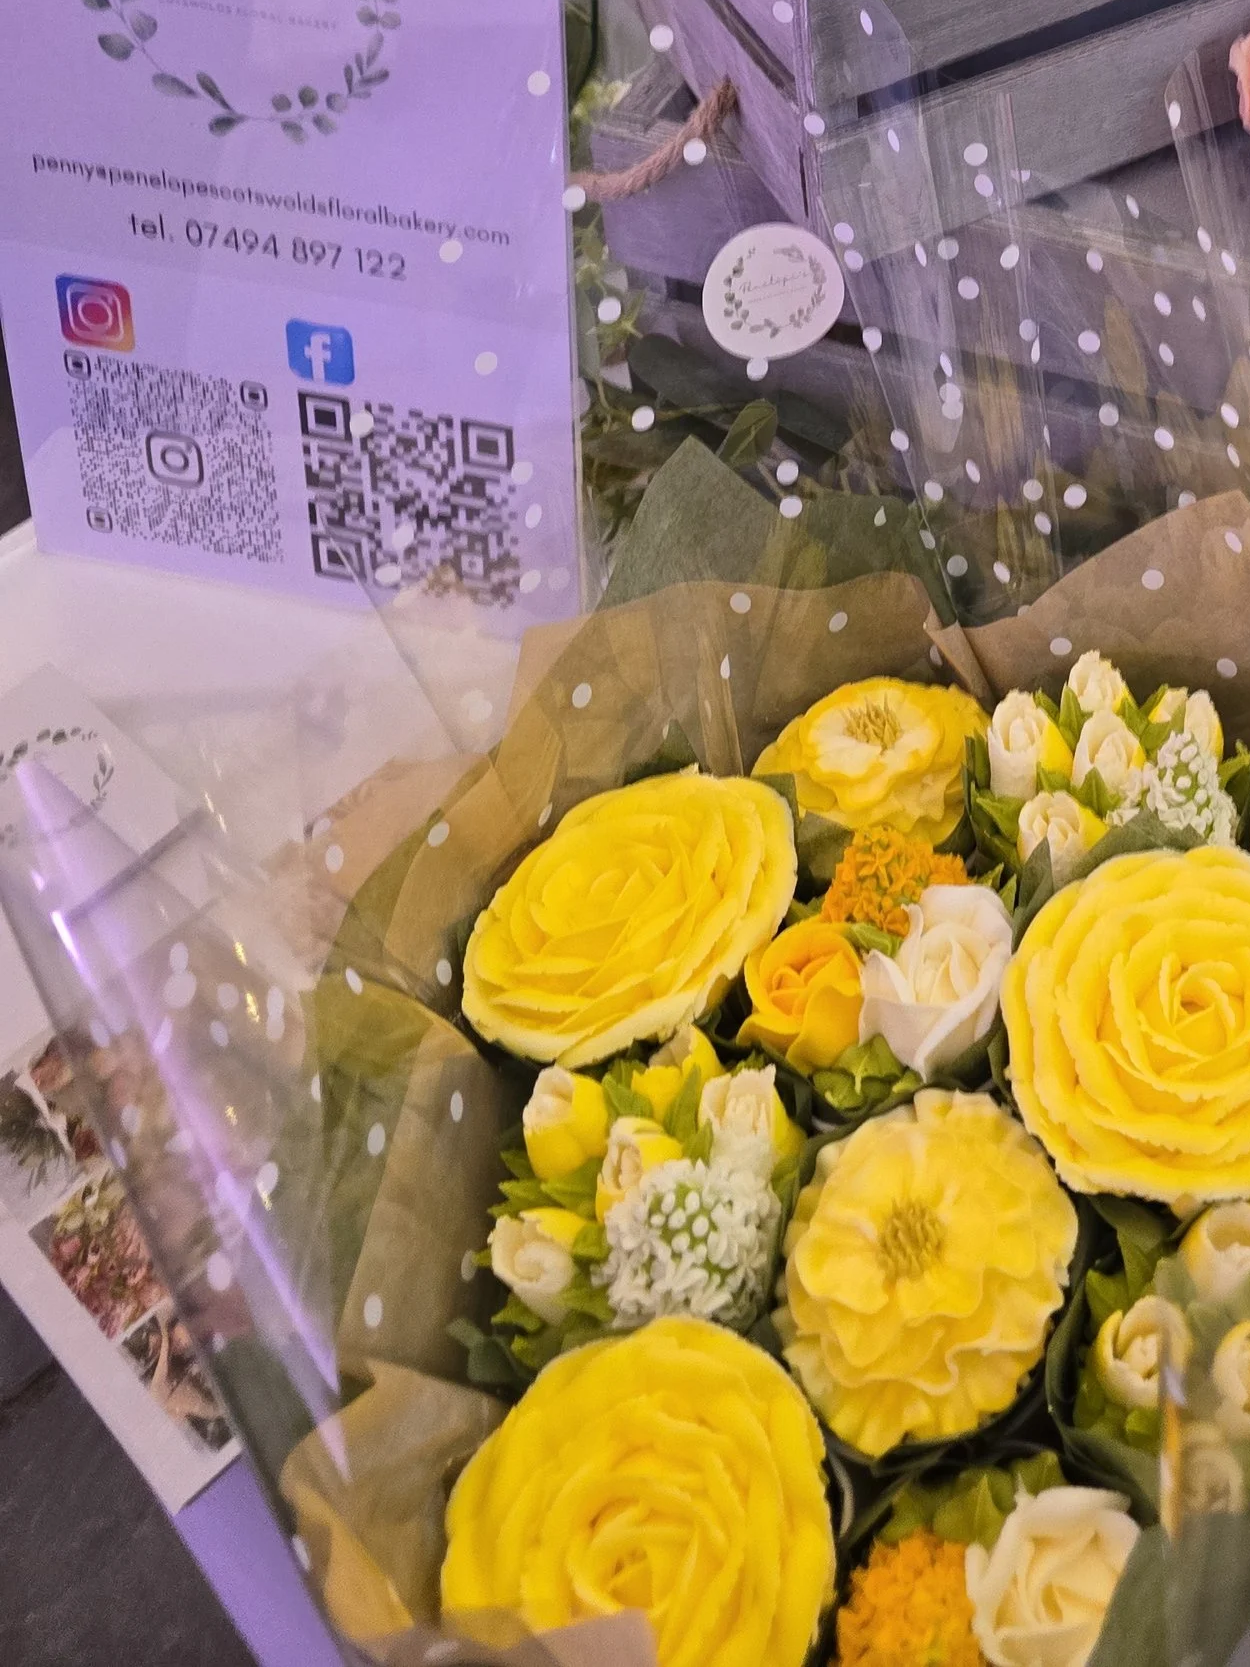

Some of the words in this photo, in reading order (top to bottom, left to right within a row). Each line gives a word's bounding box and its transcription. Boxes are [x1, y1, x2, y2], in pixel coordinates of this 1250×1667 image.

[129, 213, 174, 243] tel.
[185, 218, 279, 260] 07494
[292, 235, 342, 270] 897
[354, 246, 407, 281] 122
